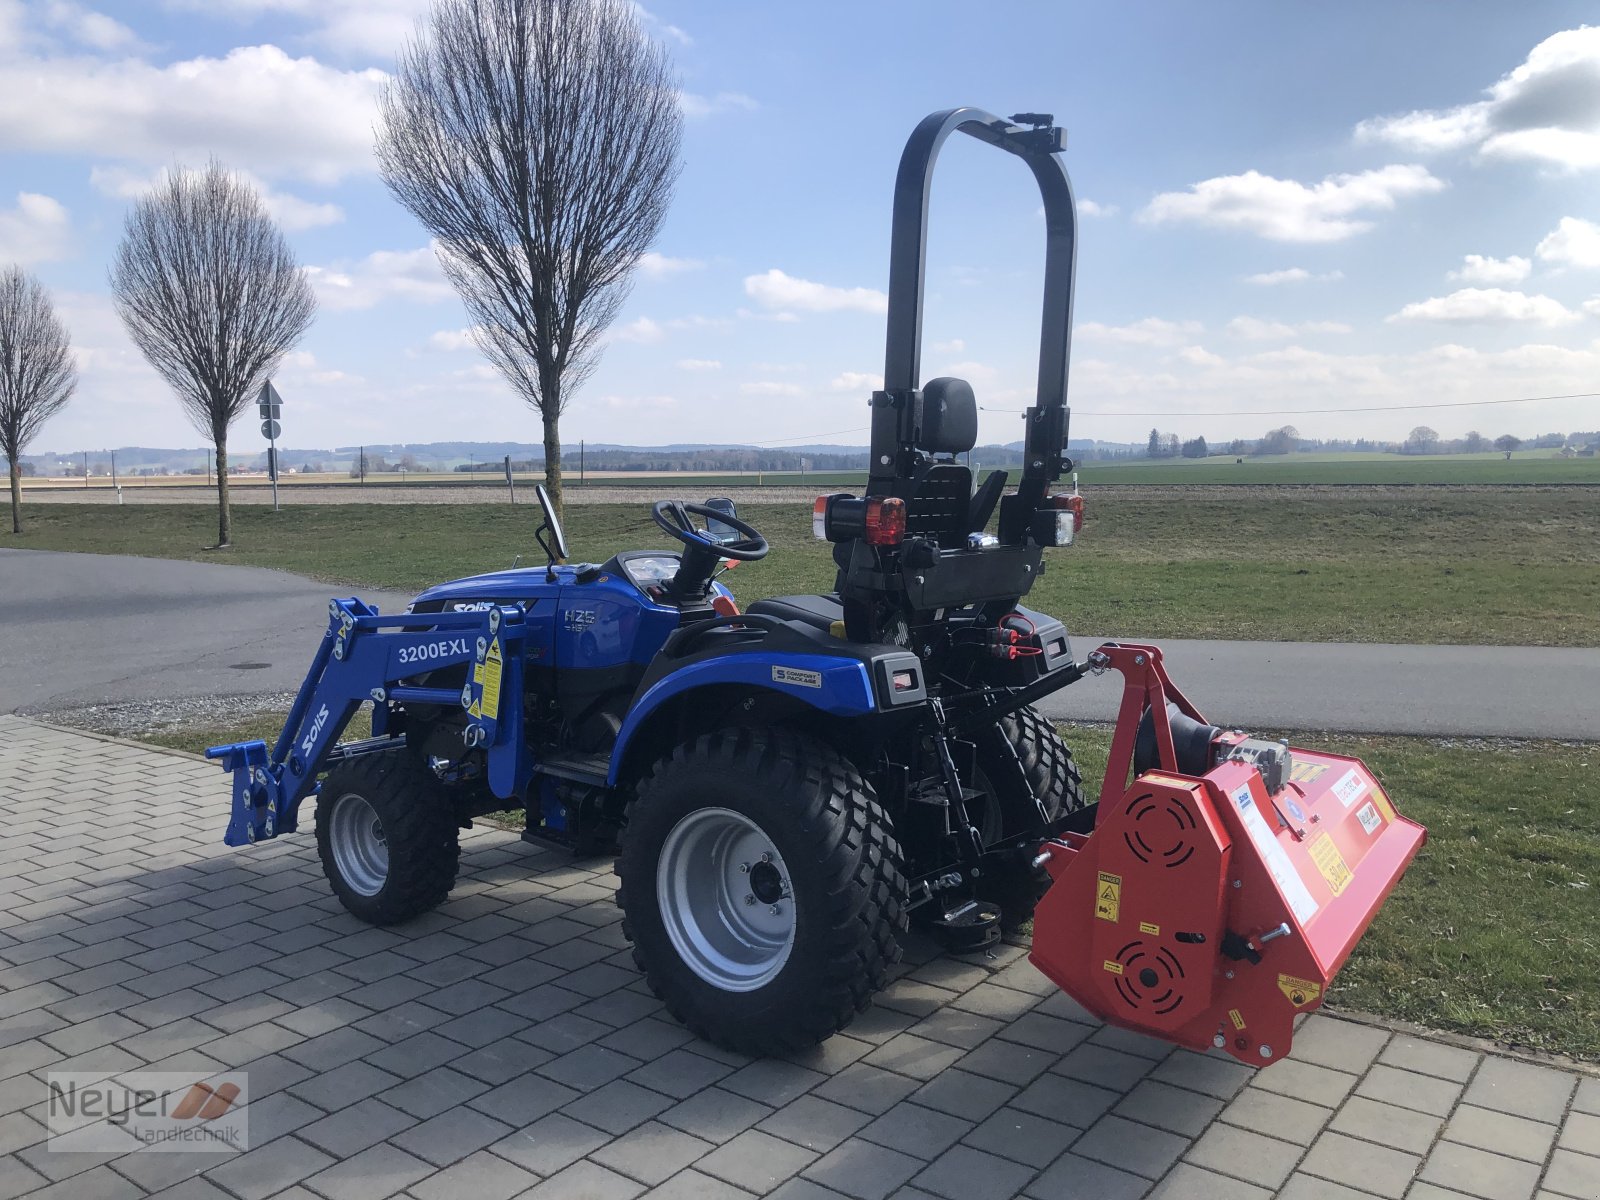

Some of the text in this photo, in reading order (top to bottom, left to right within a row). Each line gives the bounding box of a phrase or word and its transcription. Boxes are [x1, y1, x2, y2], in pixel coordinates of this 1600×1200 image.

[398, 638, 470, 664] 3200EXL
[786, 671, 816, 679] COMFORT
[786, 676, 816, 684] PACKAGE
[1100, 873, 1120, 885] DANGER
[1286, 976, 1313, 989] DANGER
